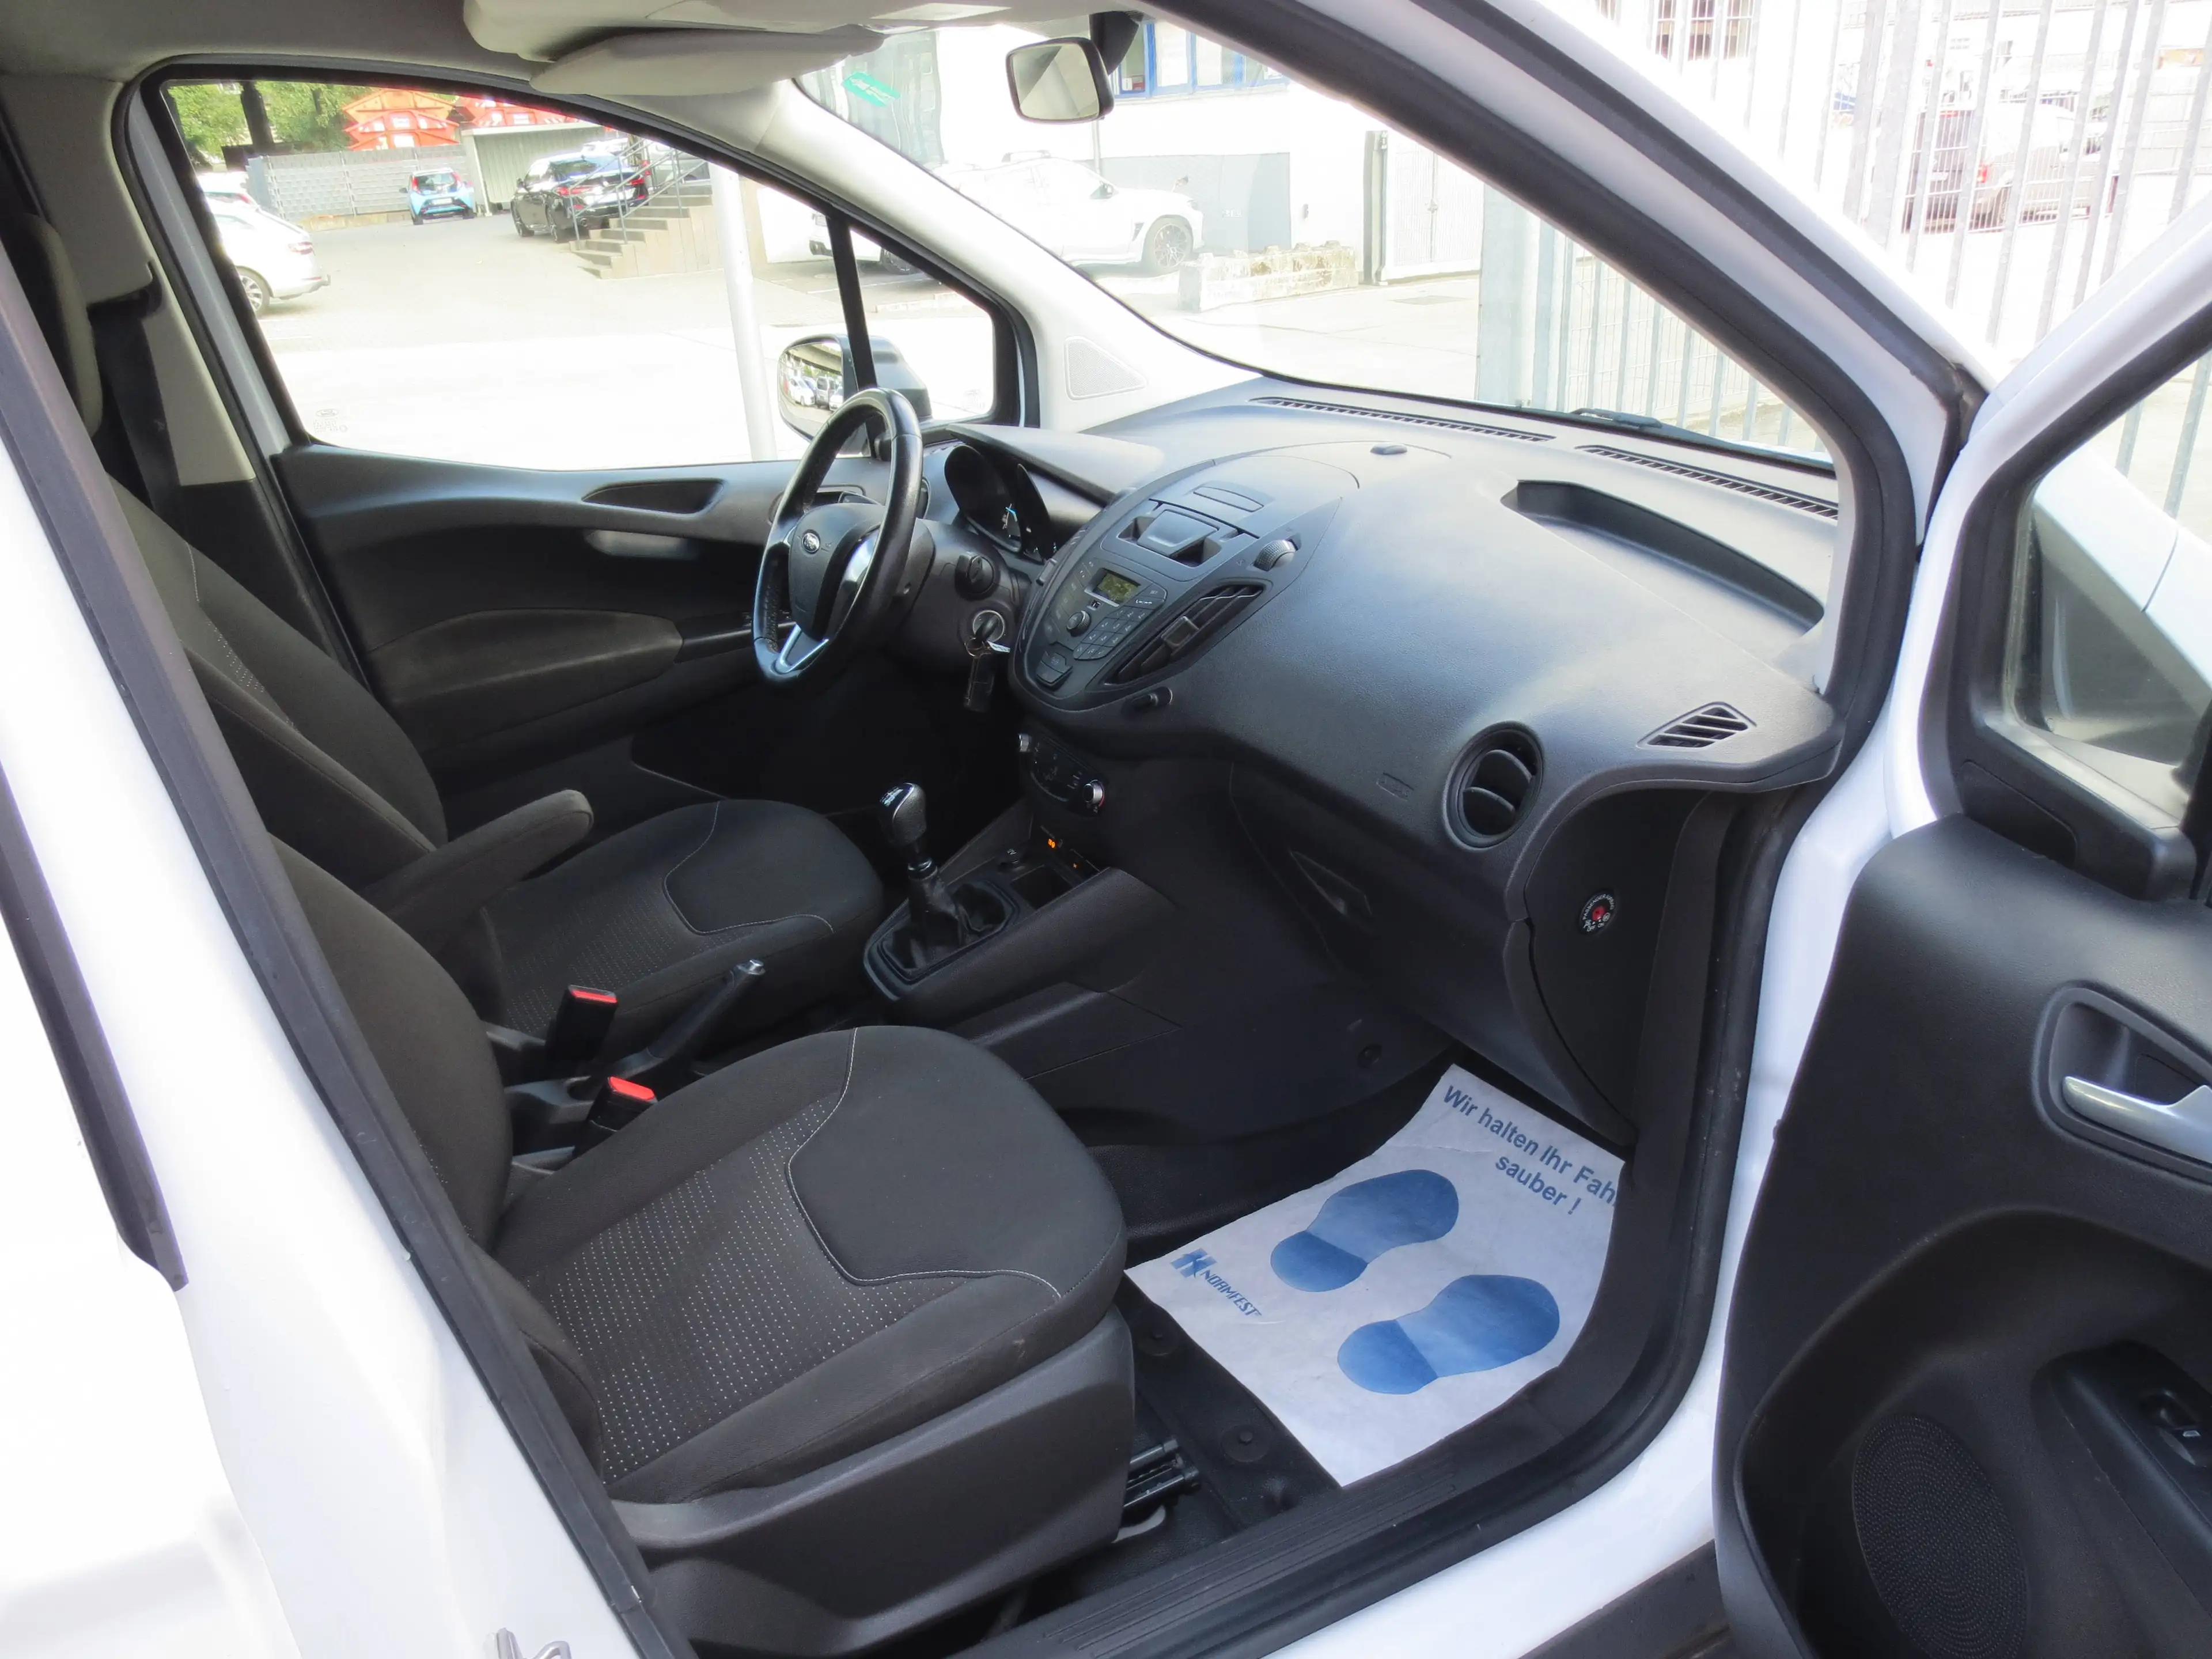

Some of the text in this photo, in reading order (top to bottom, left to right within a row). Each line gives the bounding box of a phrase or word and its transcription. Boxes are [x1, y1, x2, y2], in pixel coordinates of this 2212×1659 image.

[1443, 1085, 1616, 1207] Wir halten Ihr Fah
[1495, 1156, 1567, 1206] sauber
[1200, 1270, 1262, 1316] NORMFEST
